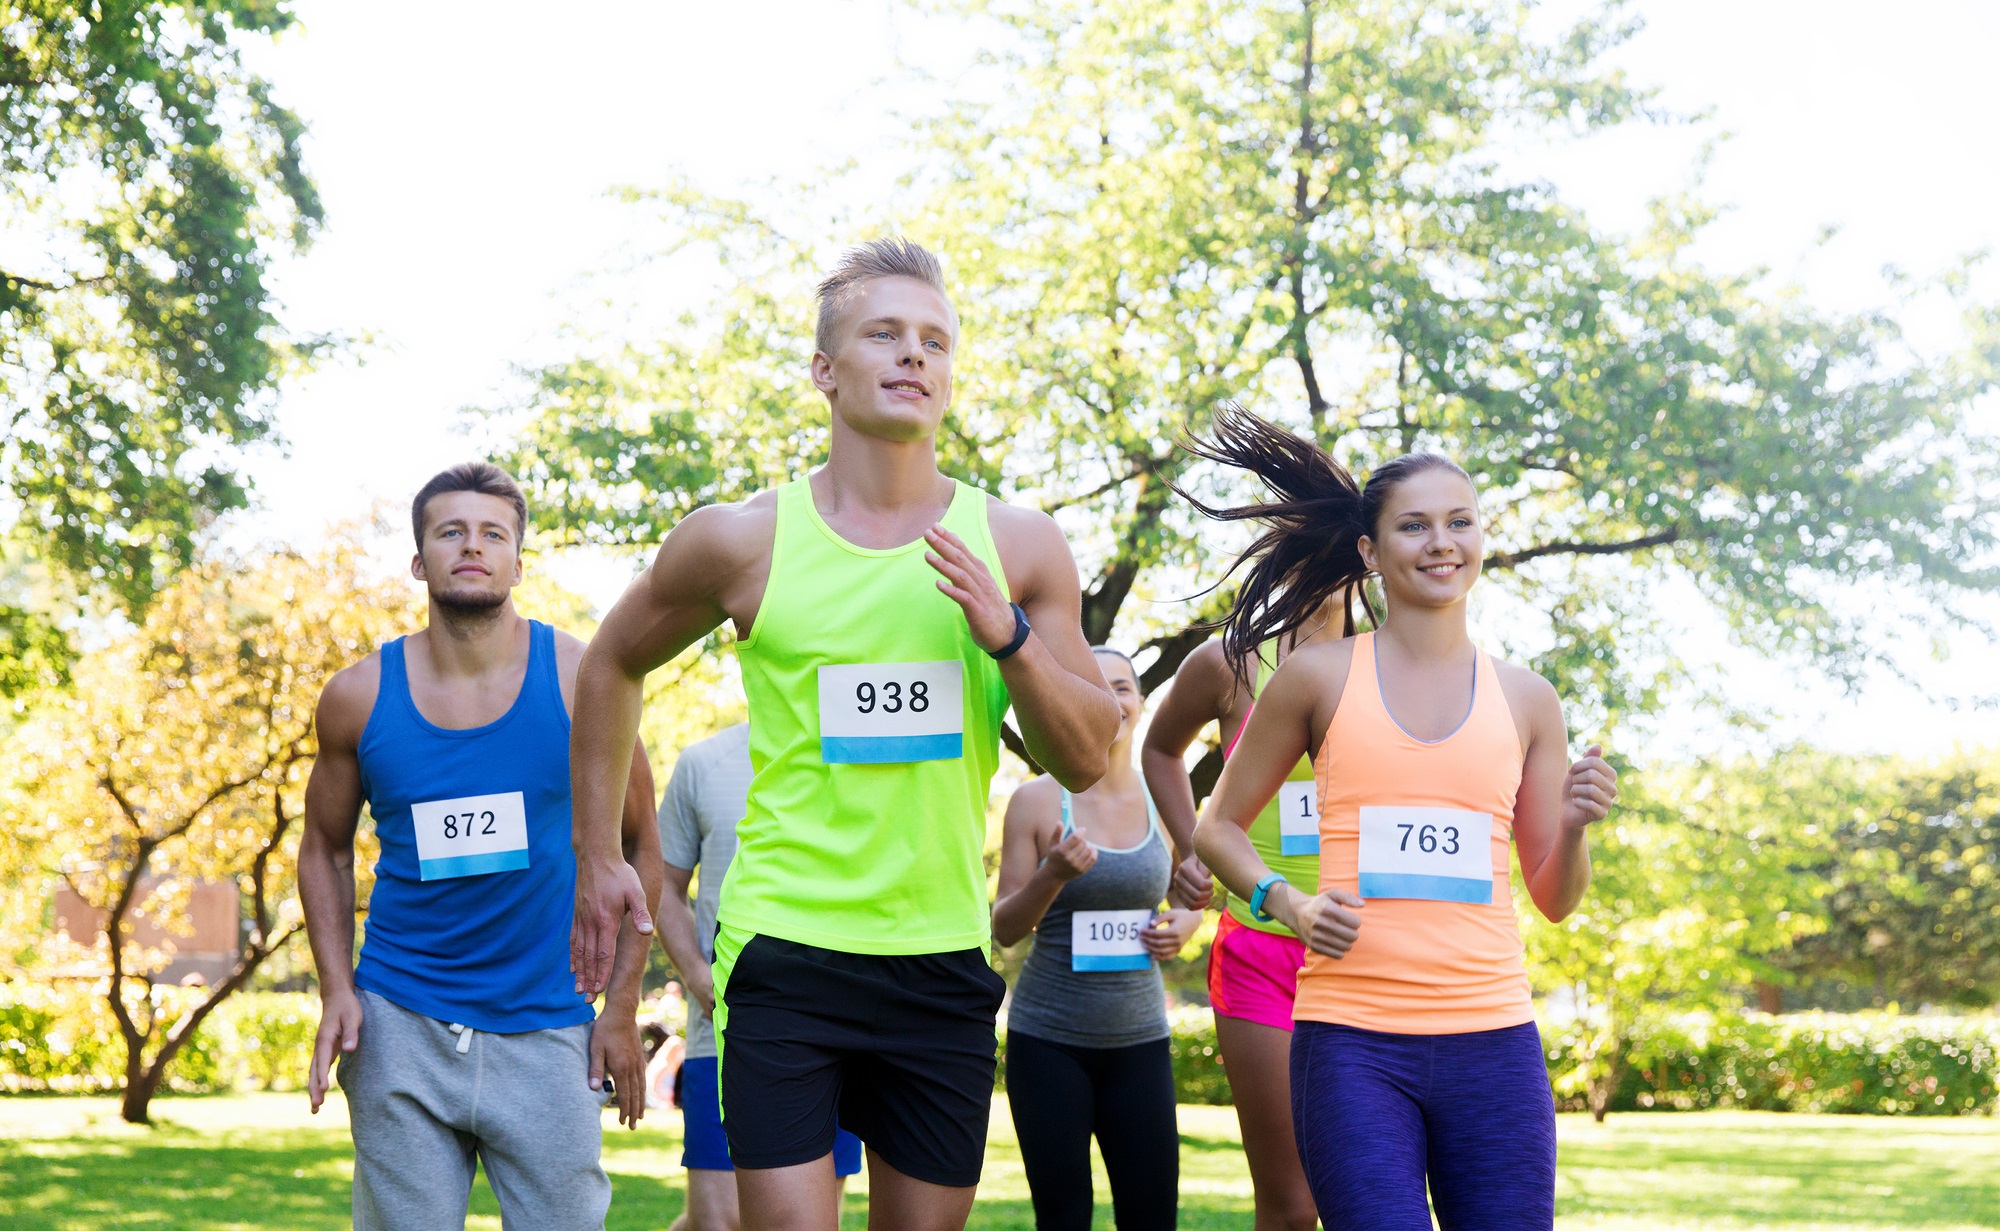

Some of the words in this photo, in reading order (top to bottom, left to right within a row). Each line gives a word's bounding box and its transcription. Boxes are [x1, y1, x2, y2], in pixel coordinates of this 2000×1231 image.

[856, 680, 930, 714] 938
[443, 810, 497, 839] 872
[1397, 823, 1460, 855] 763
[1089, 922, 1139, 941] 1095
